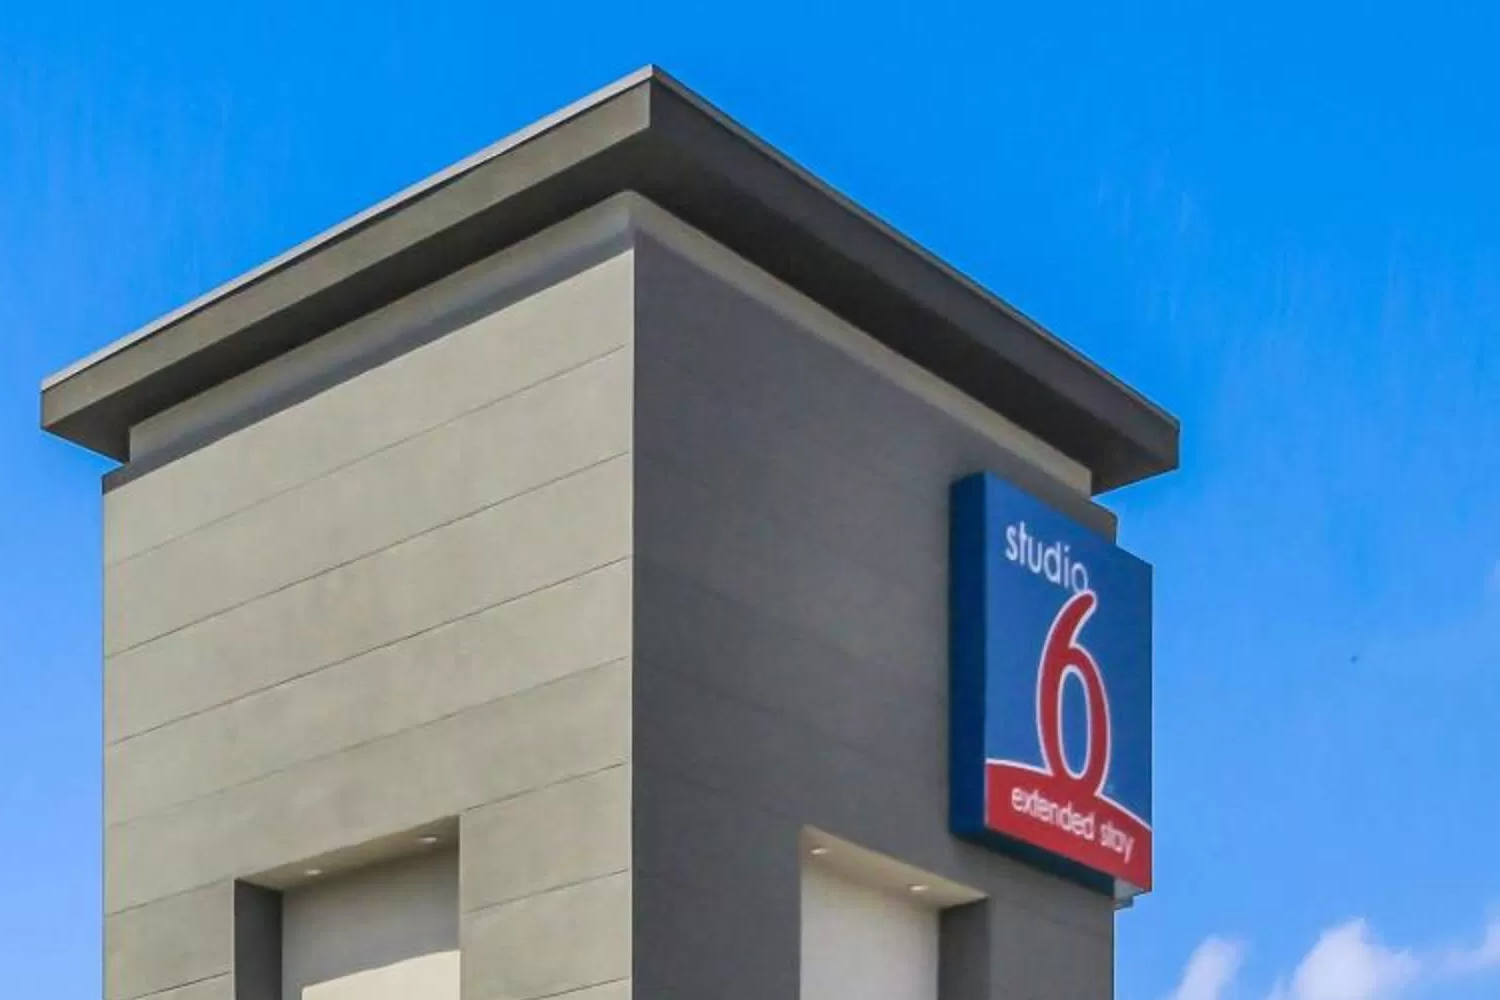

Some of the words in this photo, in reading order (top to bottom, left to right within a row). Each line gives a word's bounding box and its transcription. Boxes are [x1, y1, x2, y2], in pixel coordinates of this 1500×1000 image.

[1005, 521, 1089, 593] studio
[1036, 589, 1111, 792] 6
[1011, 787, 1095, 841] extended
[1100, 820, 1134, 864] stay
